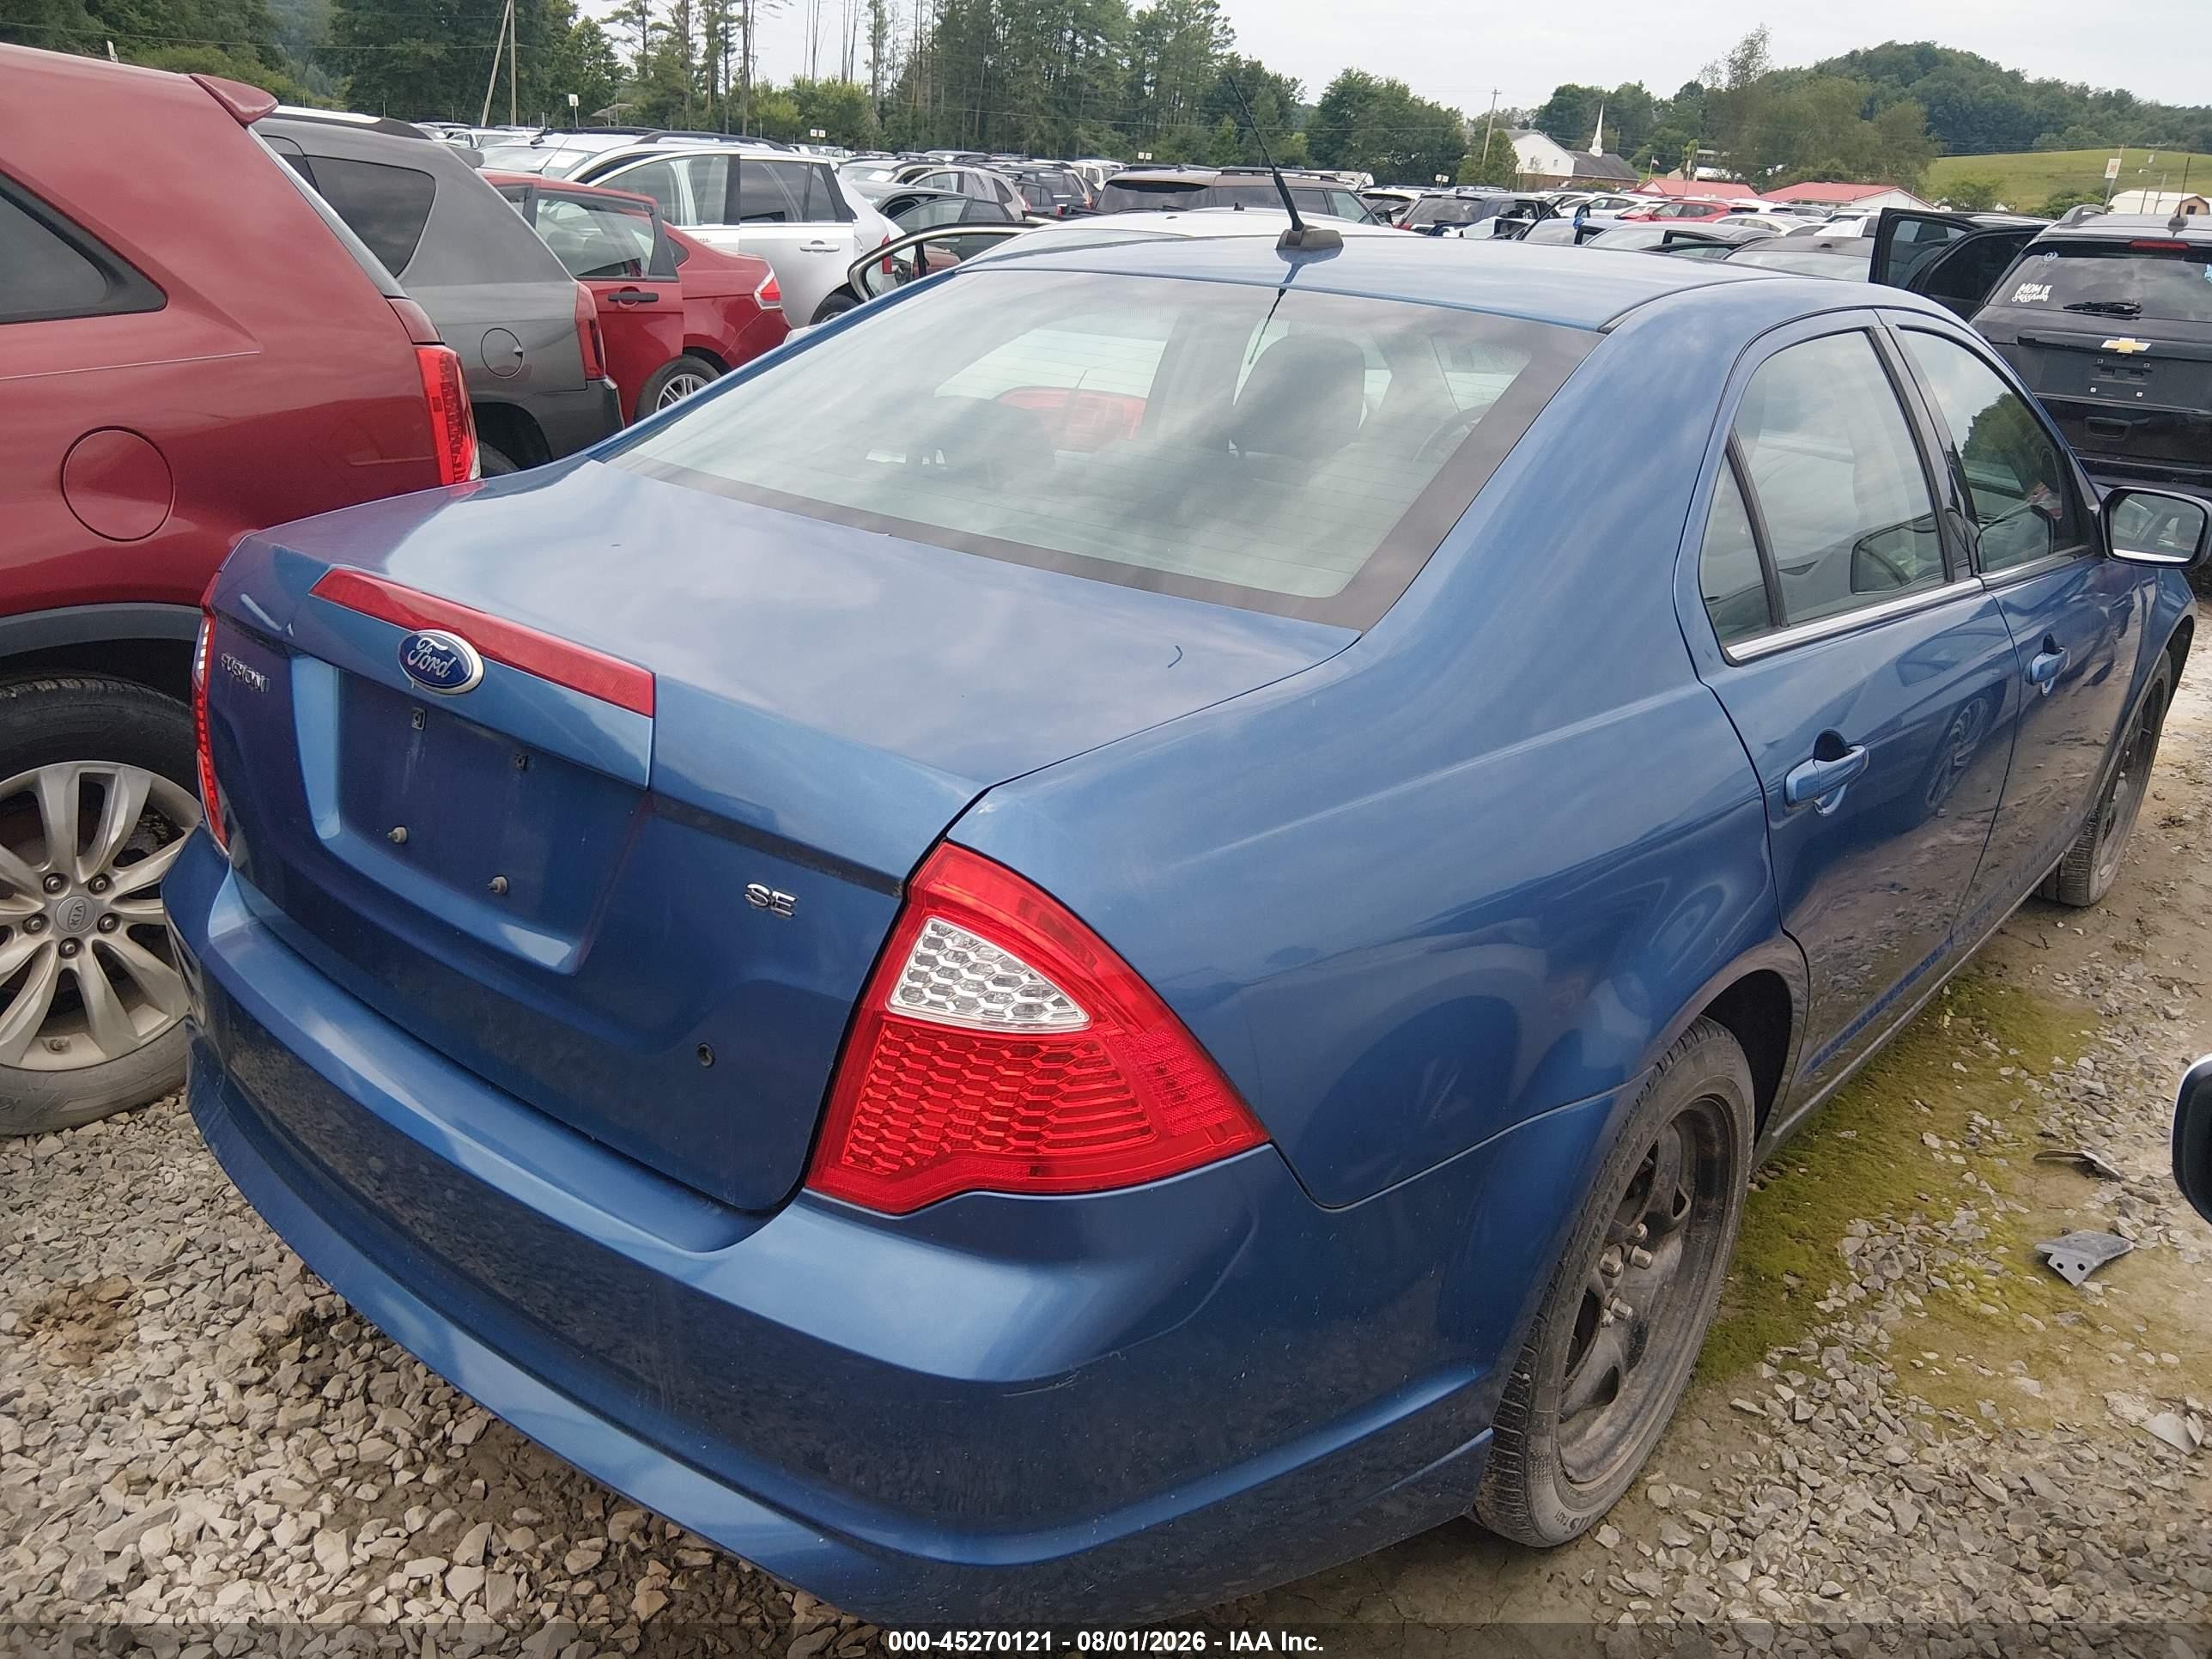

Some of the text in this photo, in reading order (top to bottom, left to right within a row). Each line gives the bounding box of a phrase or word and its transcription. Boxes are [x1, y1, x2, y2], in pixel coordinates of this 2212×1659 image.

[221, 653, 270, 693] FUSION
[407, 637, 457, 678] Ford
[70, 904, 84, 926] KIA
[744, 883, 797, 917] SE
